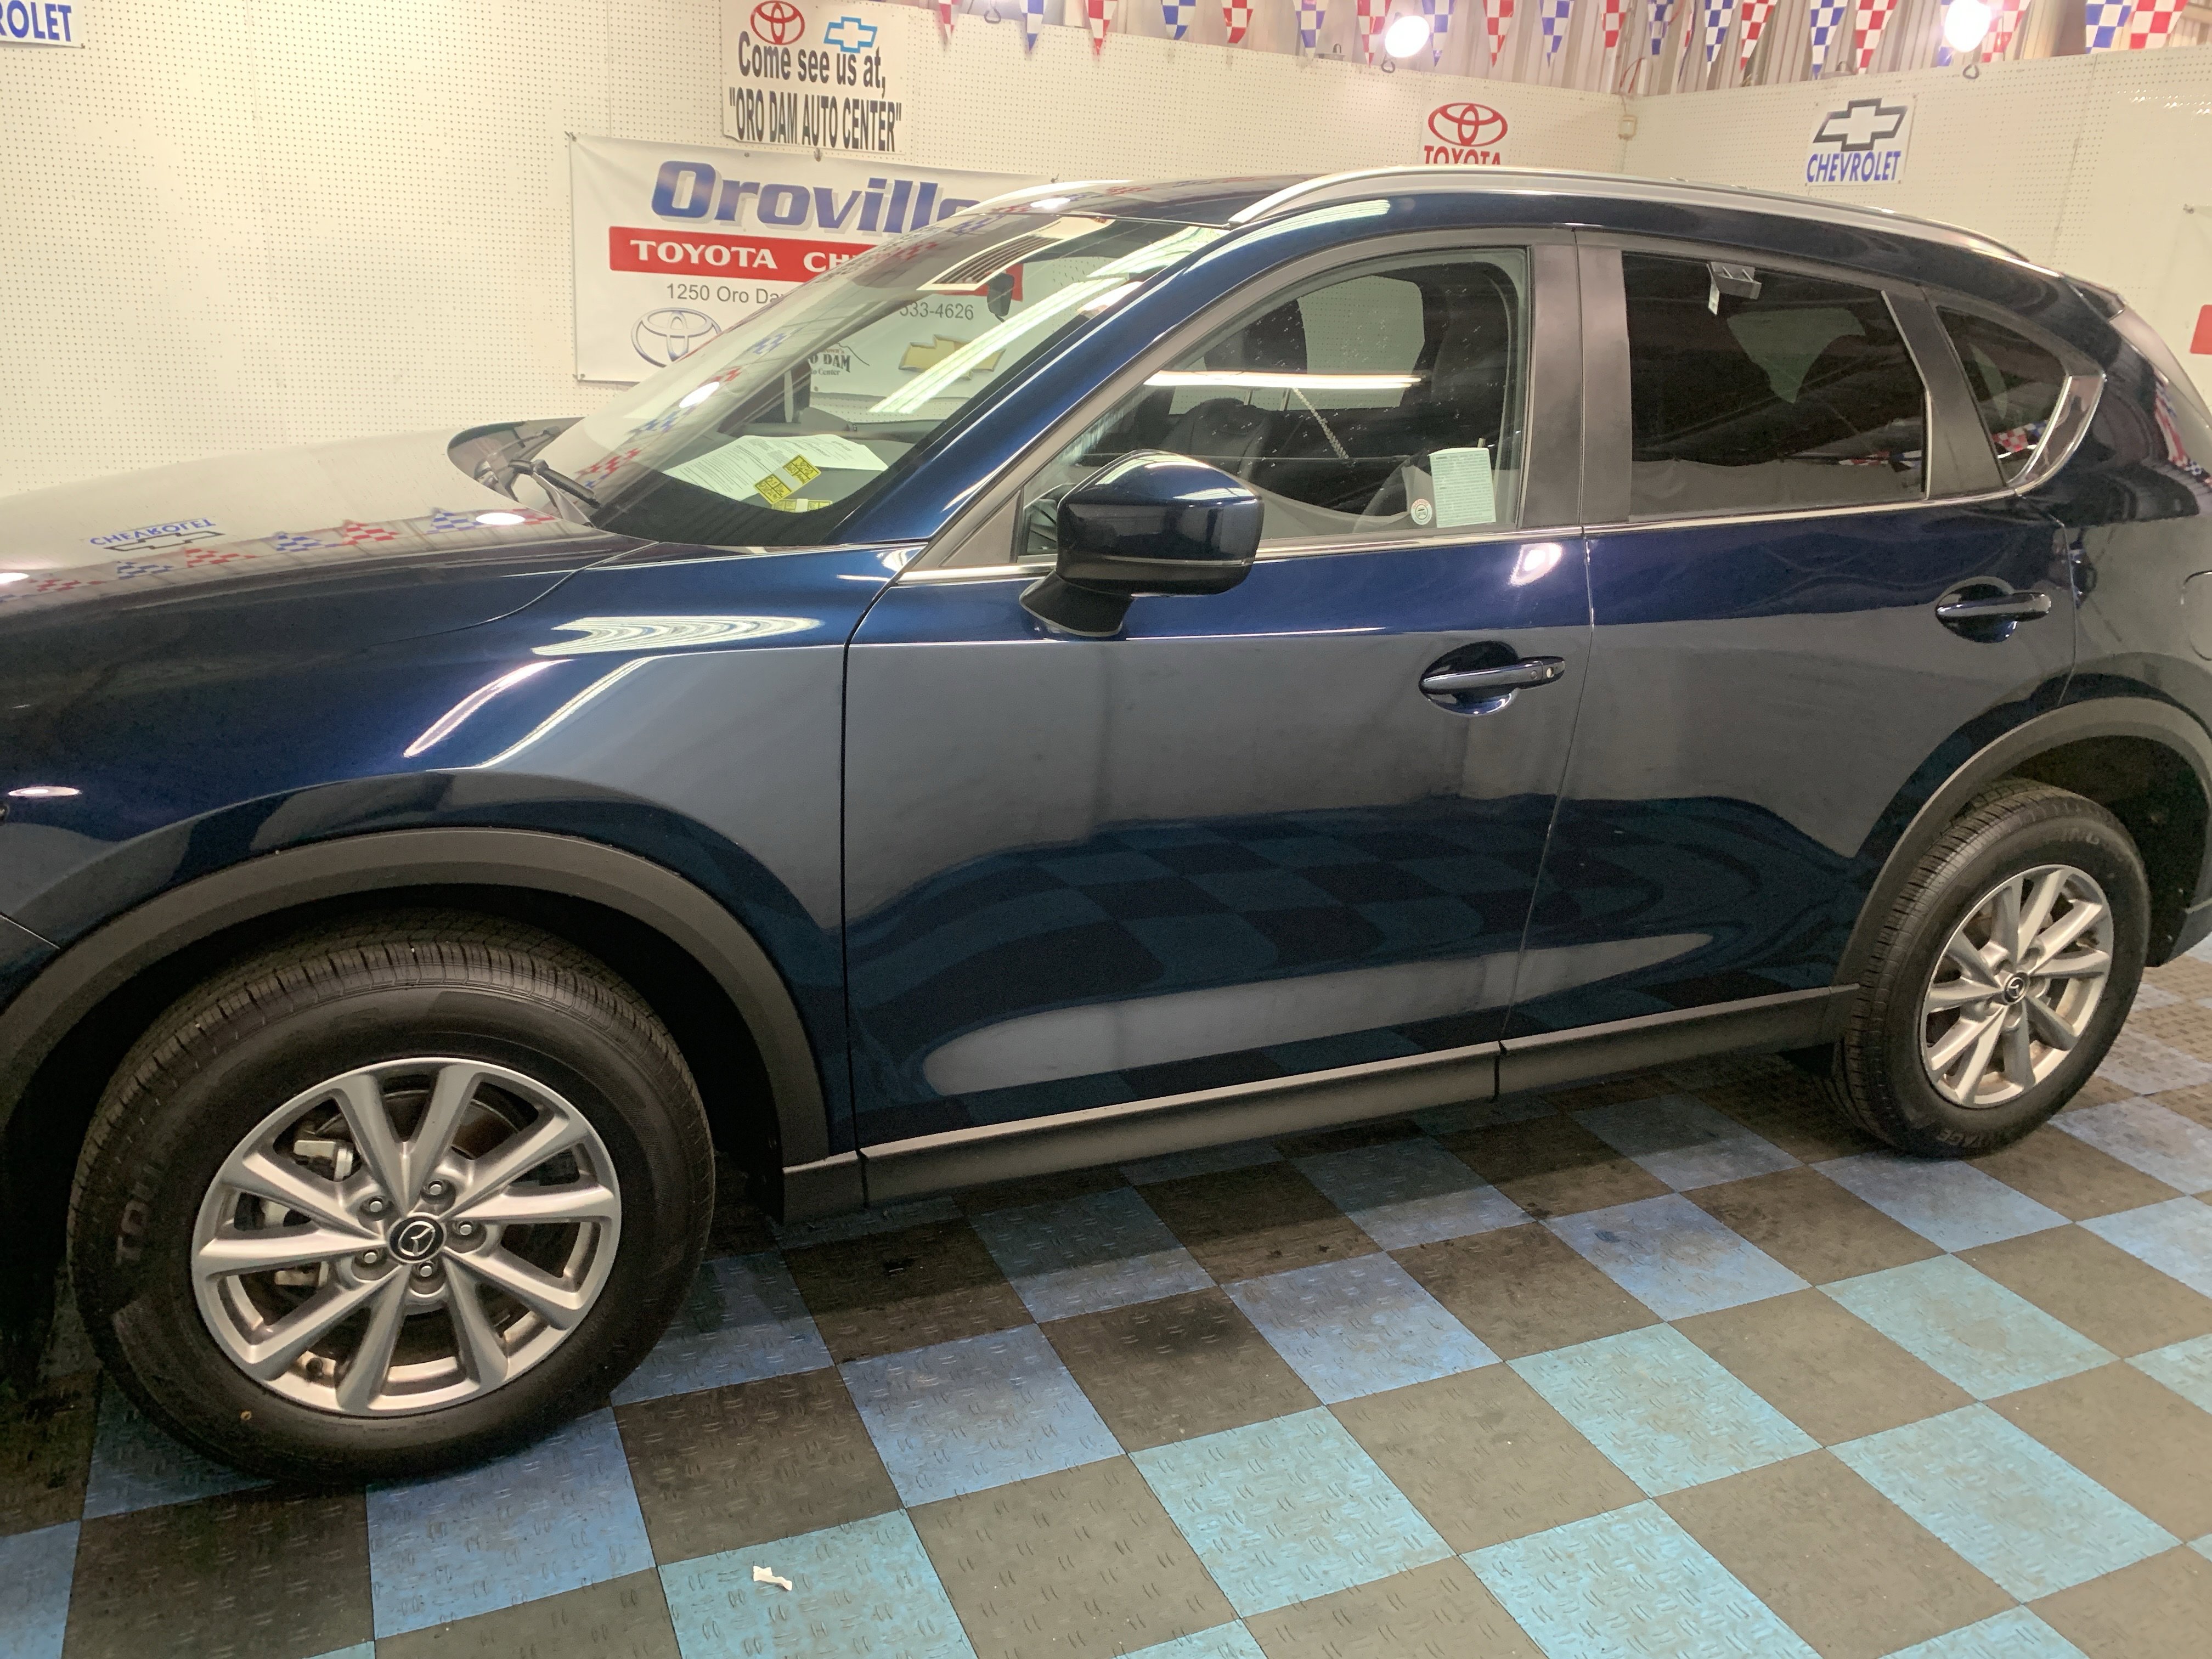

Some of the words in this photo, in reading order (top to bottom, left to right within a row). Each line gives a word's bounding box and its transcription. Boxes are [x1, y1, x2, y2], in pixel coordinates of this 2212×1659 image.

[0, 0, 71, 42] OLET
[738, 31, 791, 80] Come
[798, 49, 830, 83] see
[836, 53, 857, 86] us
[863, 46, 885, 99] at,
[729, 87, 764, 142] "ORO
[769, 91, 797, 144] DAM
[802, 94, 838, 148] AUTO
[843, 97, 901, 152] CENTER"
[1424, 145, 1501, 165] TOYOTA
[1807, 150, 1901, 183] CHEVROLET
[629, 240, 778, 270] TOYOTA
[667, 283, 710, 301] 1250
[716, 286, 749, 303] Oro
[823, 354, 851, 373] DAM
